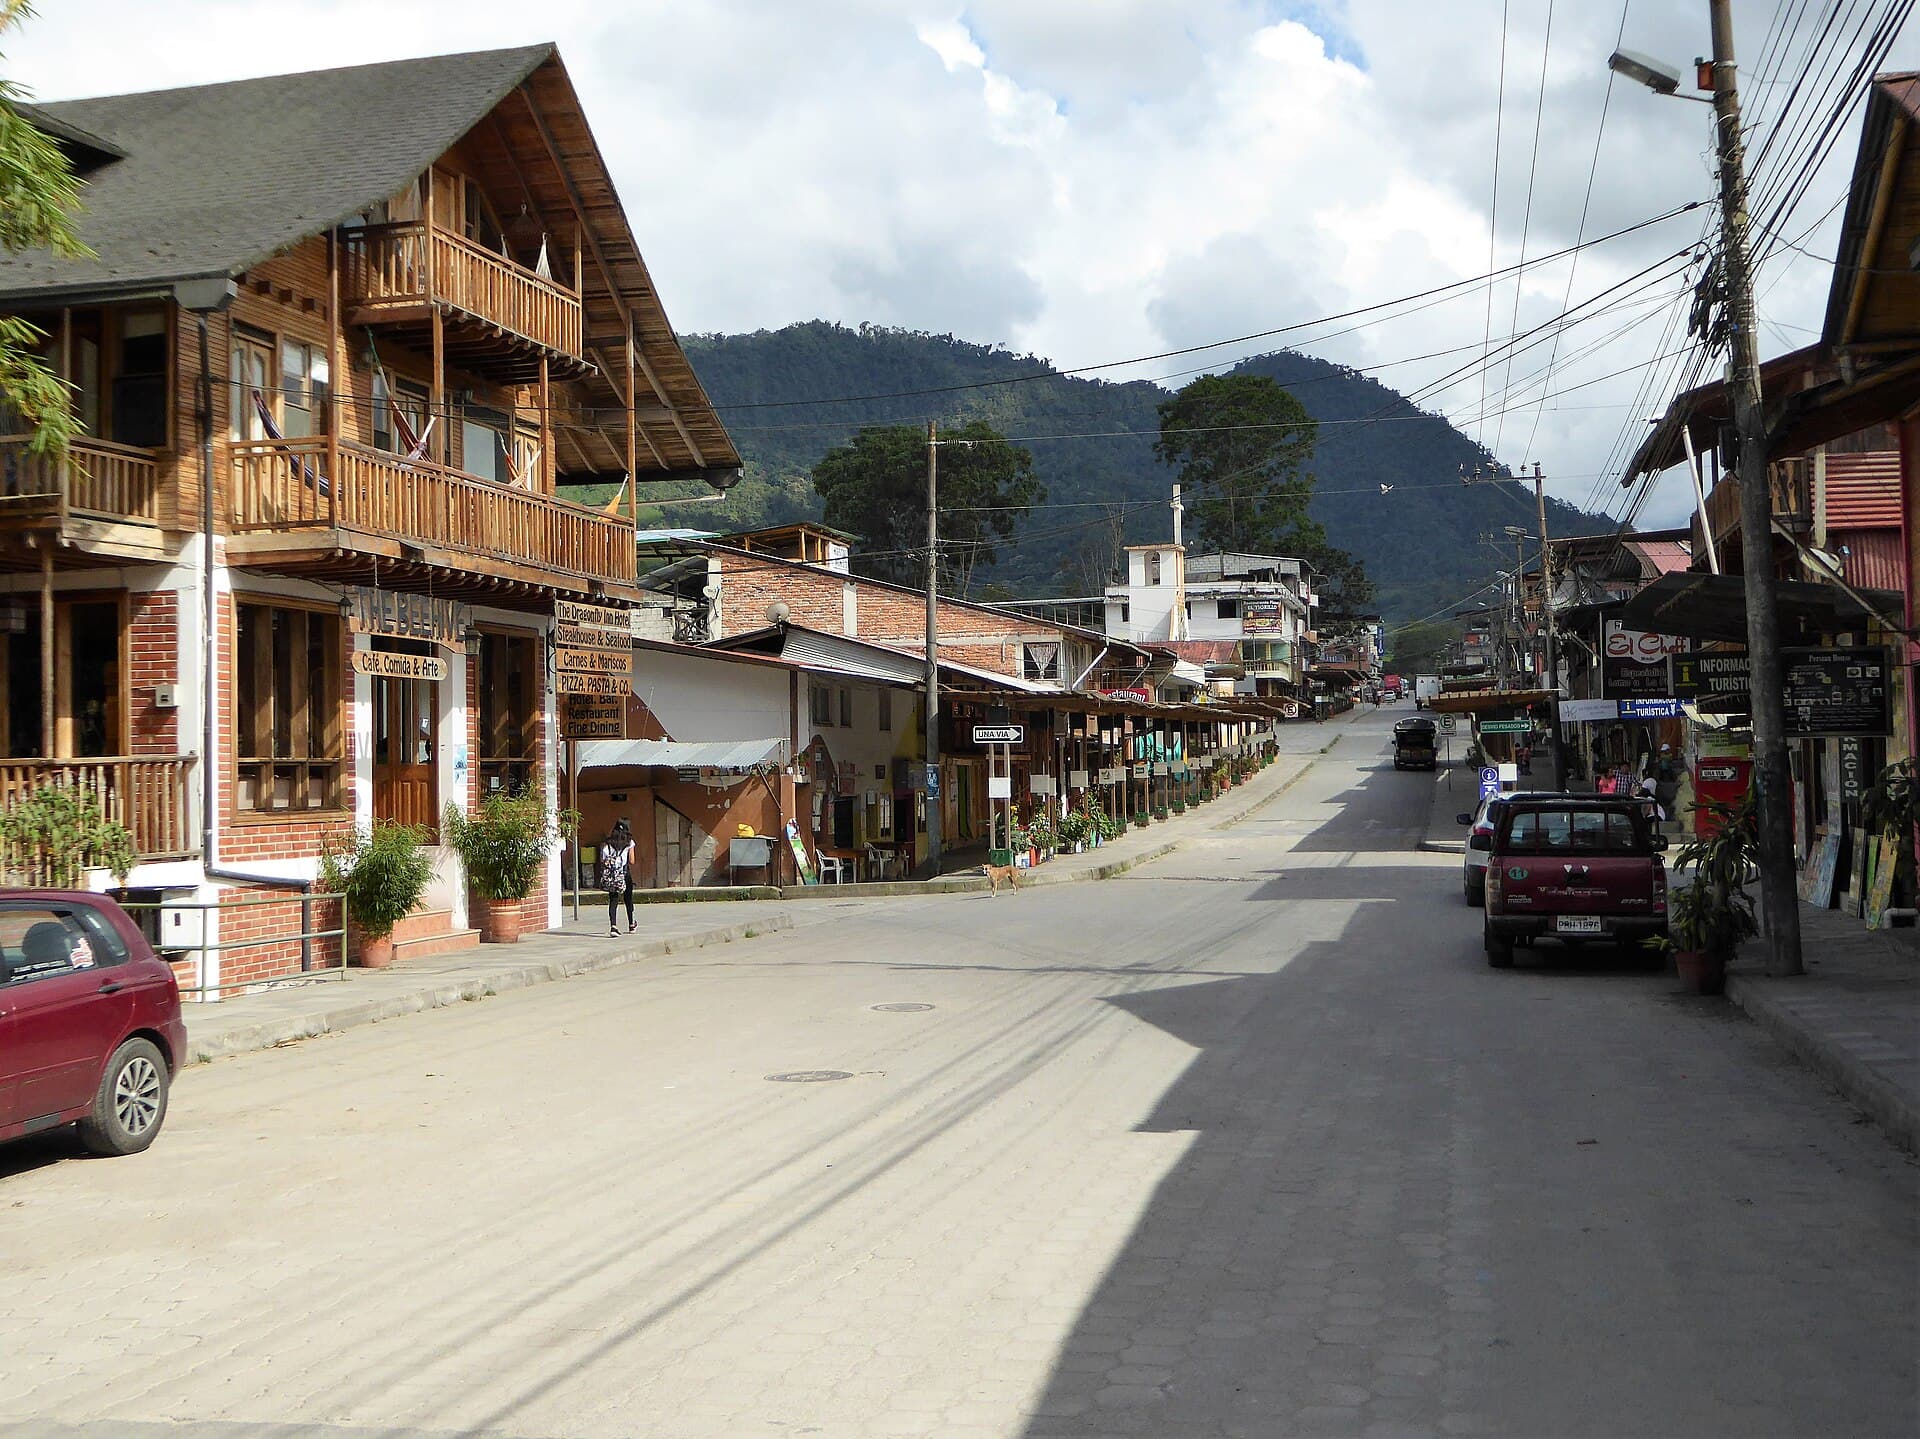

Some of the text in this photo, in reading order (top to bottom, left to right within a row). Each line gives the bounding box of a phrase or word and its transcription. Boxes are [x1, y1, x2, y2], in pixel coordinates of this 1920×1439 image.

[353, 585, 394, 634] THE
[557, 602, 631, 628] The Dragonfly Inn Hotel
[557, 625, 631, 649] Steakhouse & Seafood
[1607, 633, 1633, 655] El
[383, 655, 411, 675] Comida
[413, 657, 420, 676] &
[422, 658, 439, 677] Arte
[563, 651, 627, 671] Carnes & Mariscos
[587, 677, 610, 694] PASTA
[611, 679, 618, 694] &
[619, 679, 630, 695] CO.
[568, 707, 619, 720] Restaurant
[1635, 706, 1670, 717] TURÍSTICA
[567, 720, 620, 734] Fine Dining
[978, 730, 1009, 738] UNA VIA
